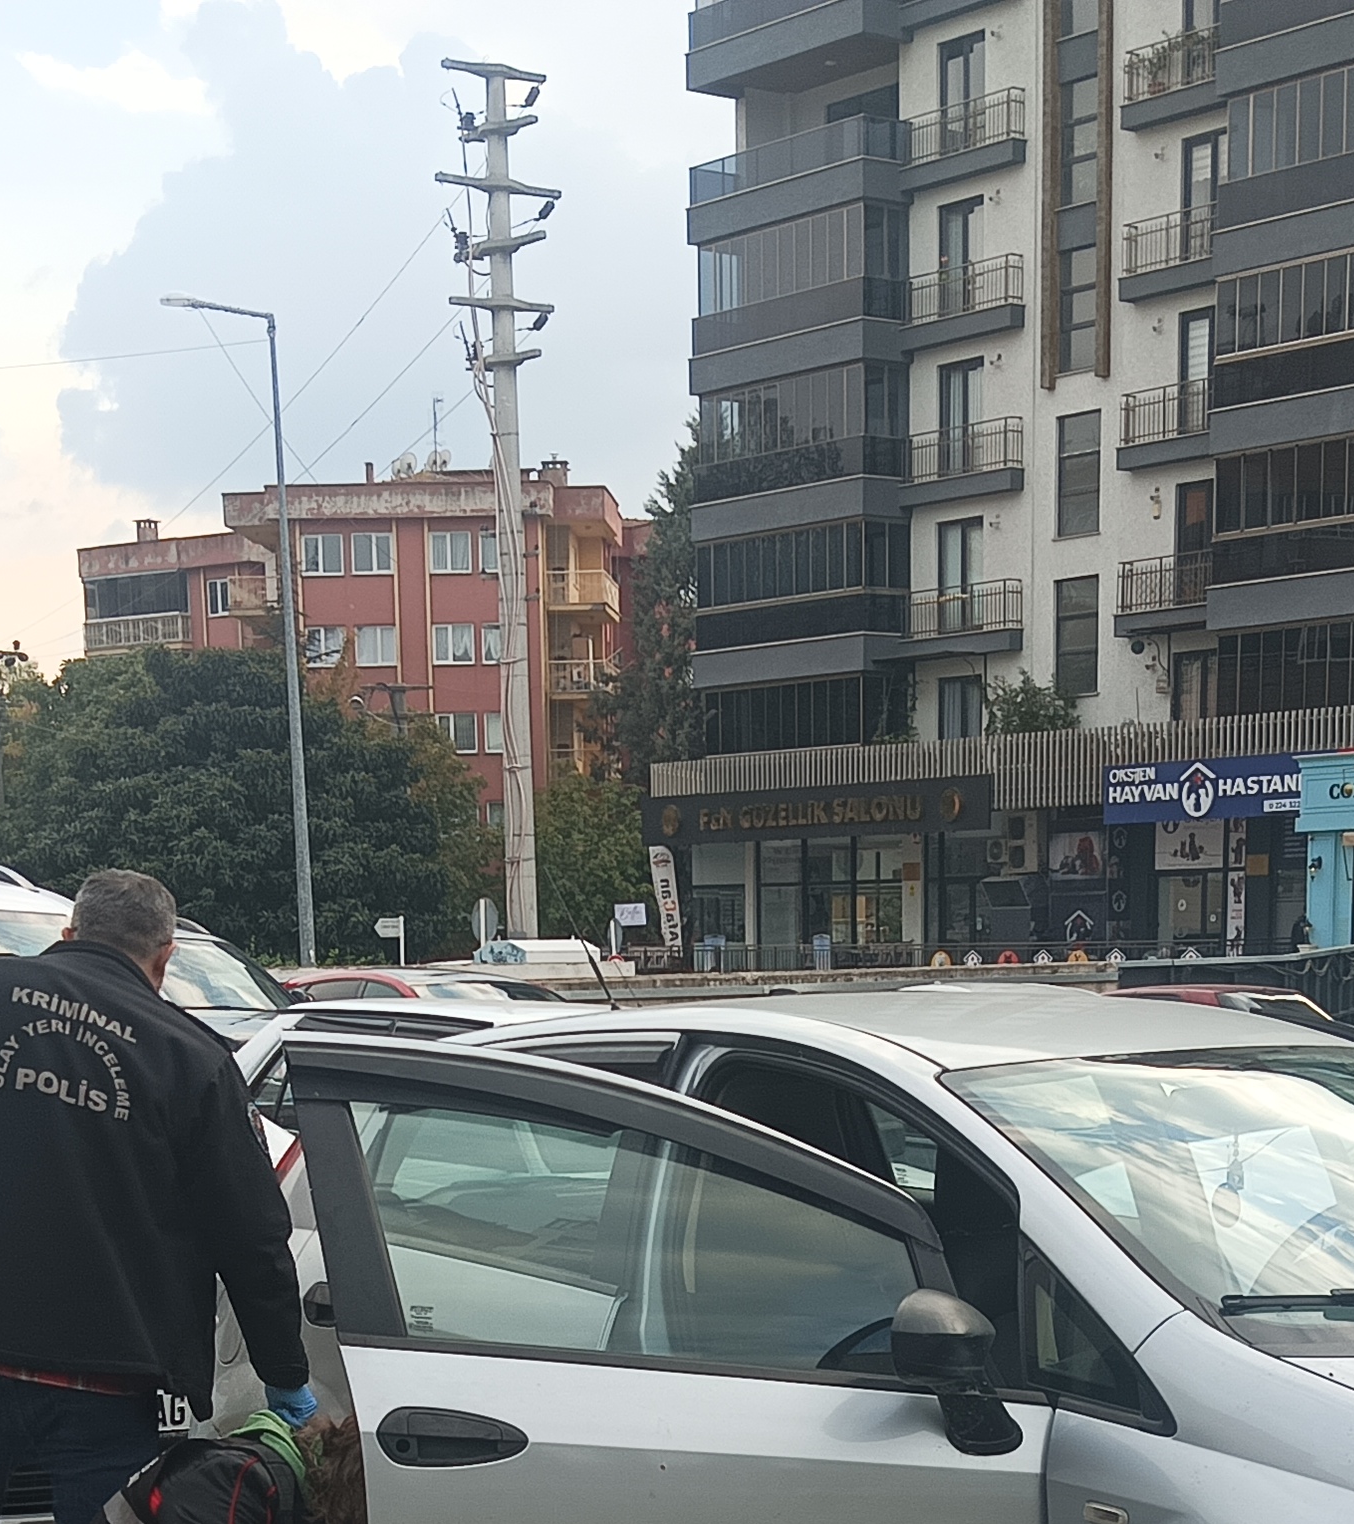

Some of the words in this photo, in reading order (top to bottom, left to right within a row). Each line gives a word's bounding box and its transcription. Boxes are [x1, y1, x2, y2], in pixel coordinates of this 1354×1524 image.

[833, 795, 922, 824] SALONU
[1108, 783, 1179, 804] HAYVAN
[11, 986, 137, 1044] KRİMİNAL
[15, 1067, 108, 1112] POLİS
[21, 1018, 71, 1038] YERİ
[76, 1024, 131, 1121] İNCELEME
